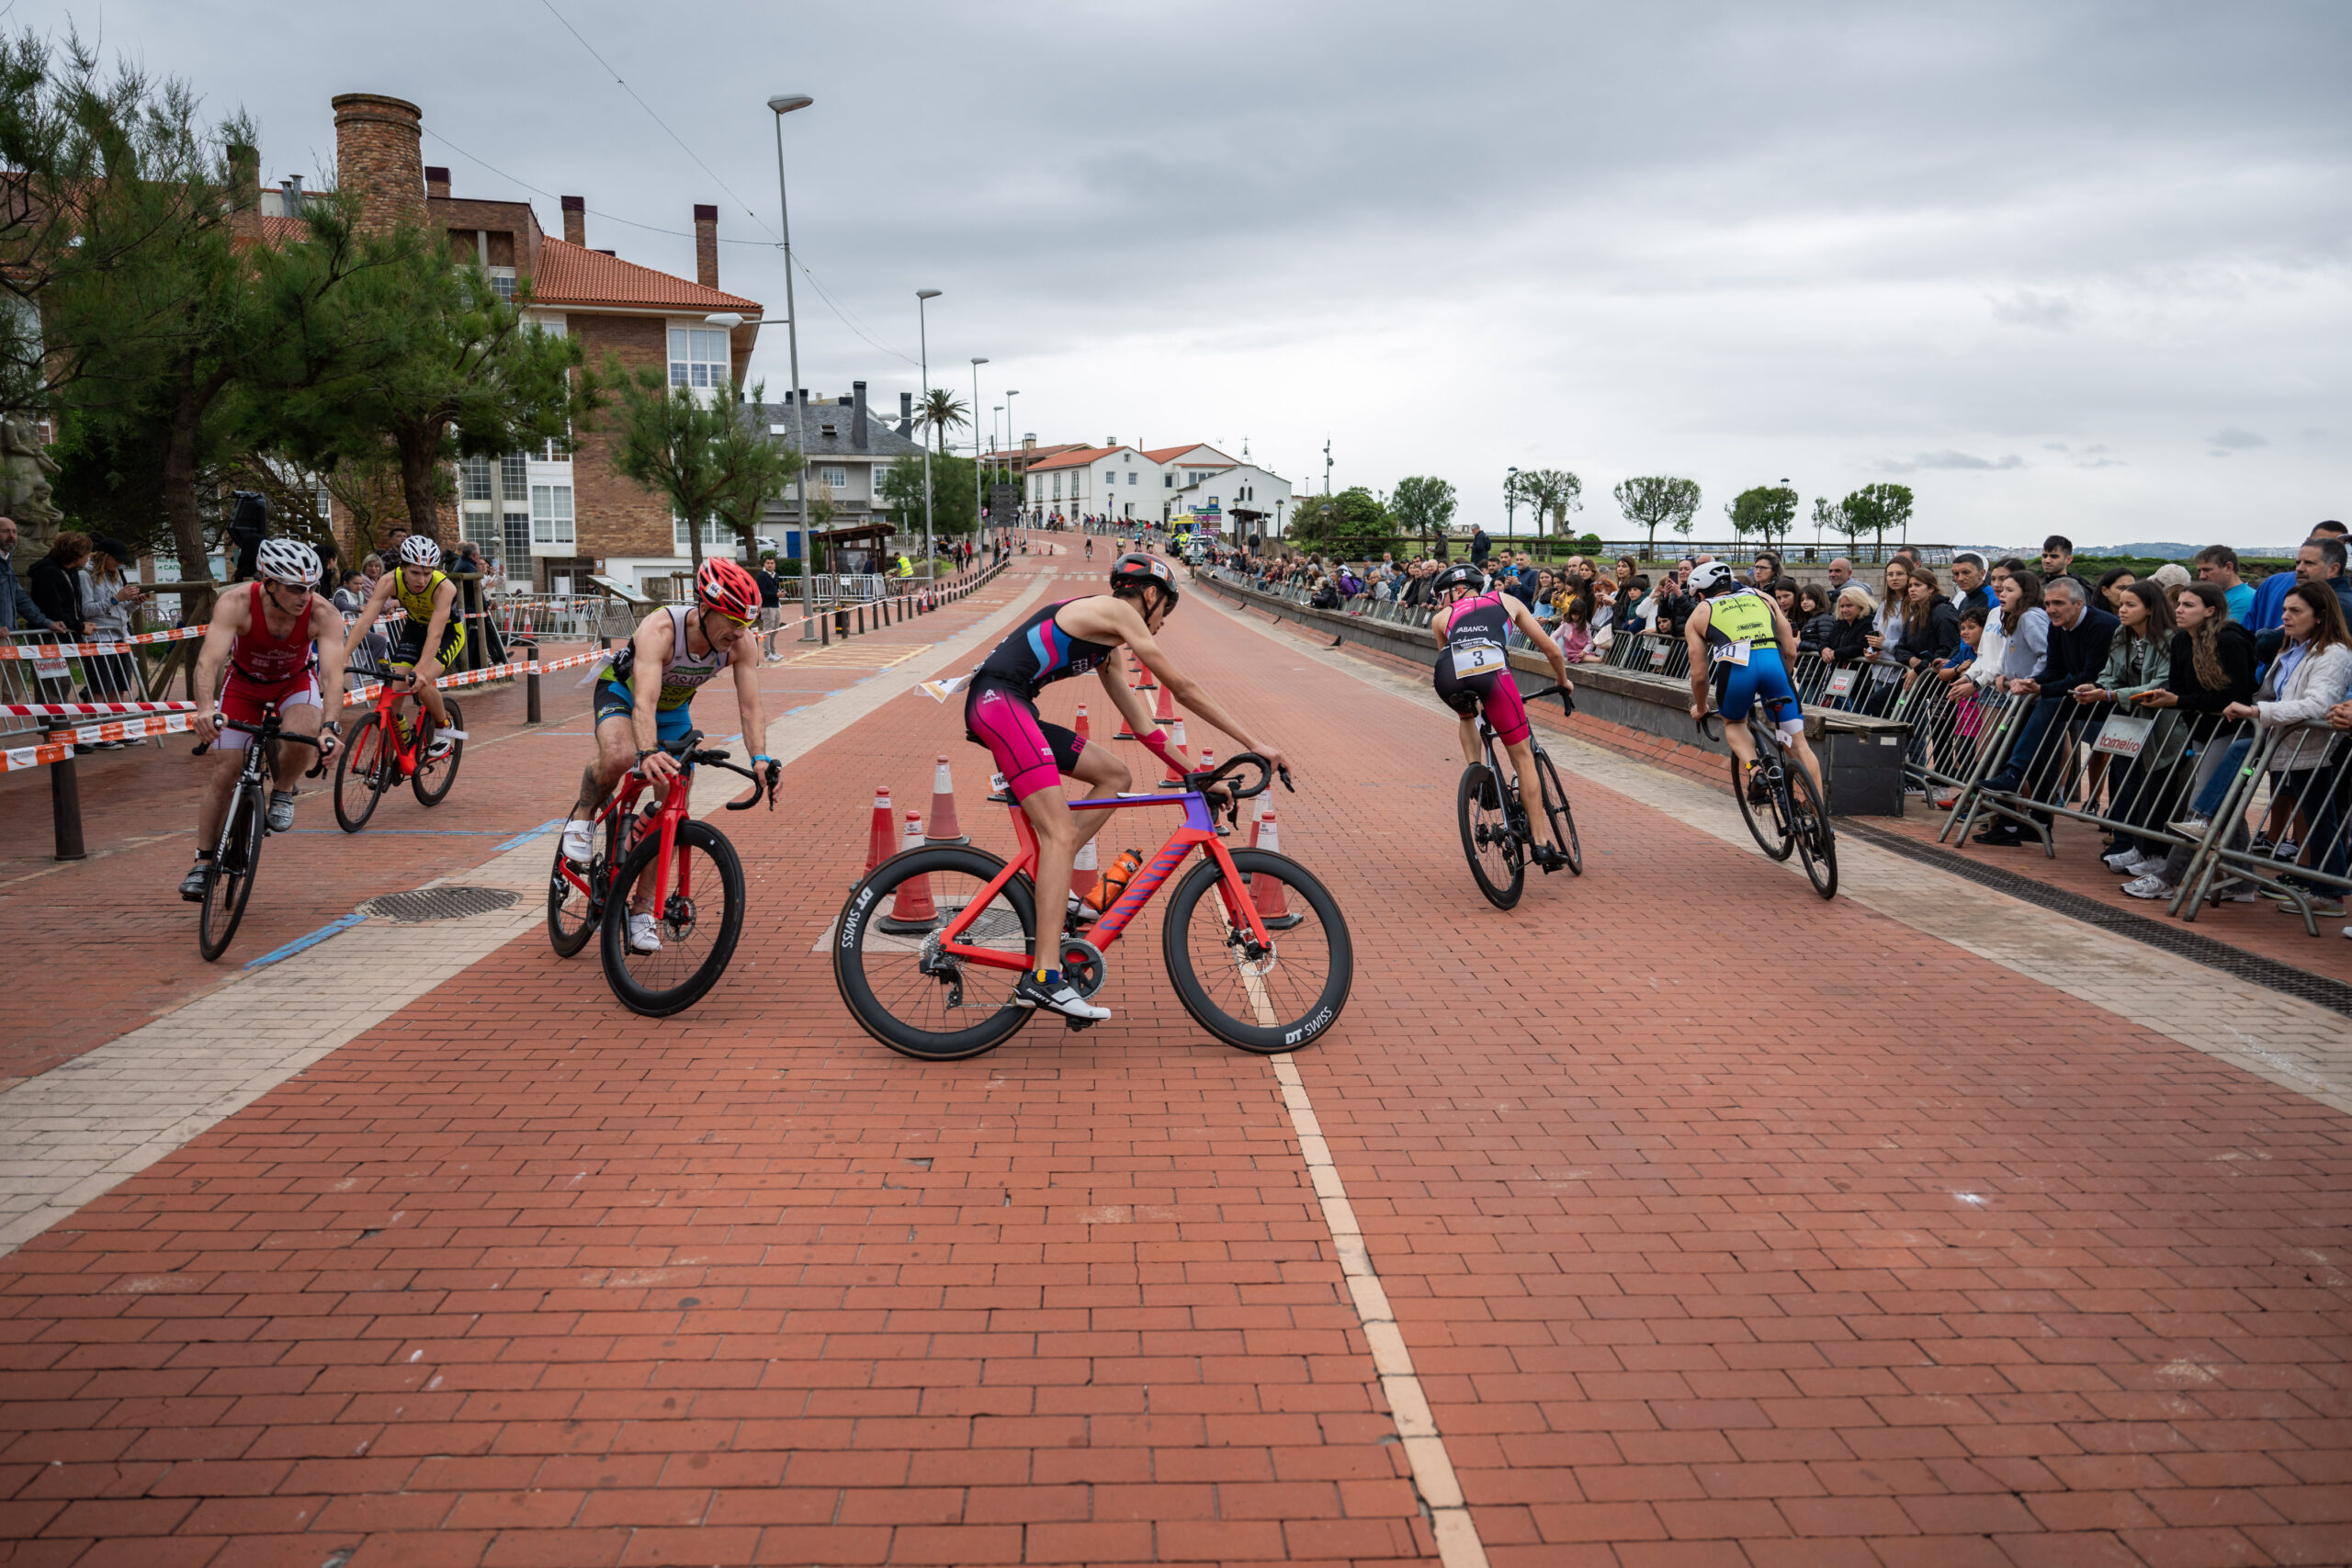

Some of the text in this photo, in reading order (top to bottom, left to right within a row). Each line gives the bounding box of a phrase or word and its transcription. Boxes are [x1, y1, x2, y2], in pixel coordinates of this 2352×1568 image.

[1455, 626, 1489, 634] ABANCA
[1473, 650, 1485, 667] 3
[1099, 843, 1193, 931] CANYON
[842, 886, 875, 949] DT SWISS
[1026, 987, 1052, 1003] SCOTT
[1285, 1006, 1332, 1045] DT SWISS
